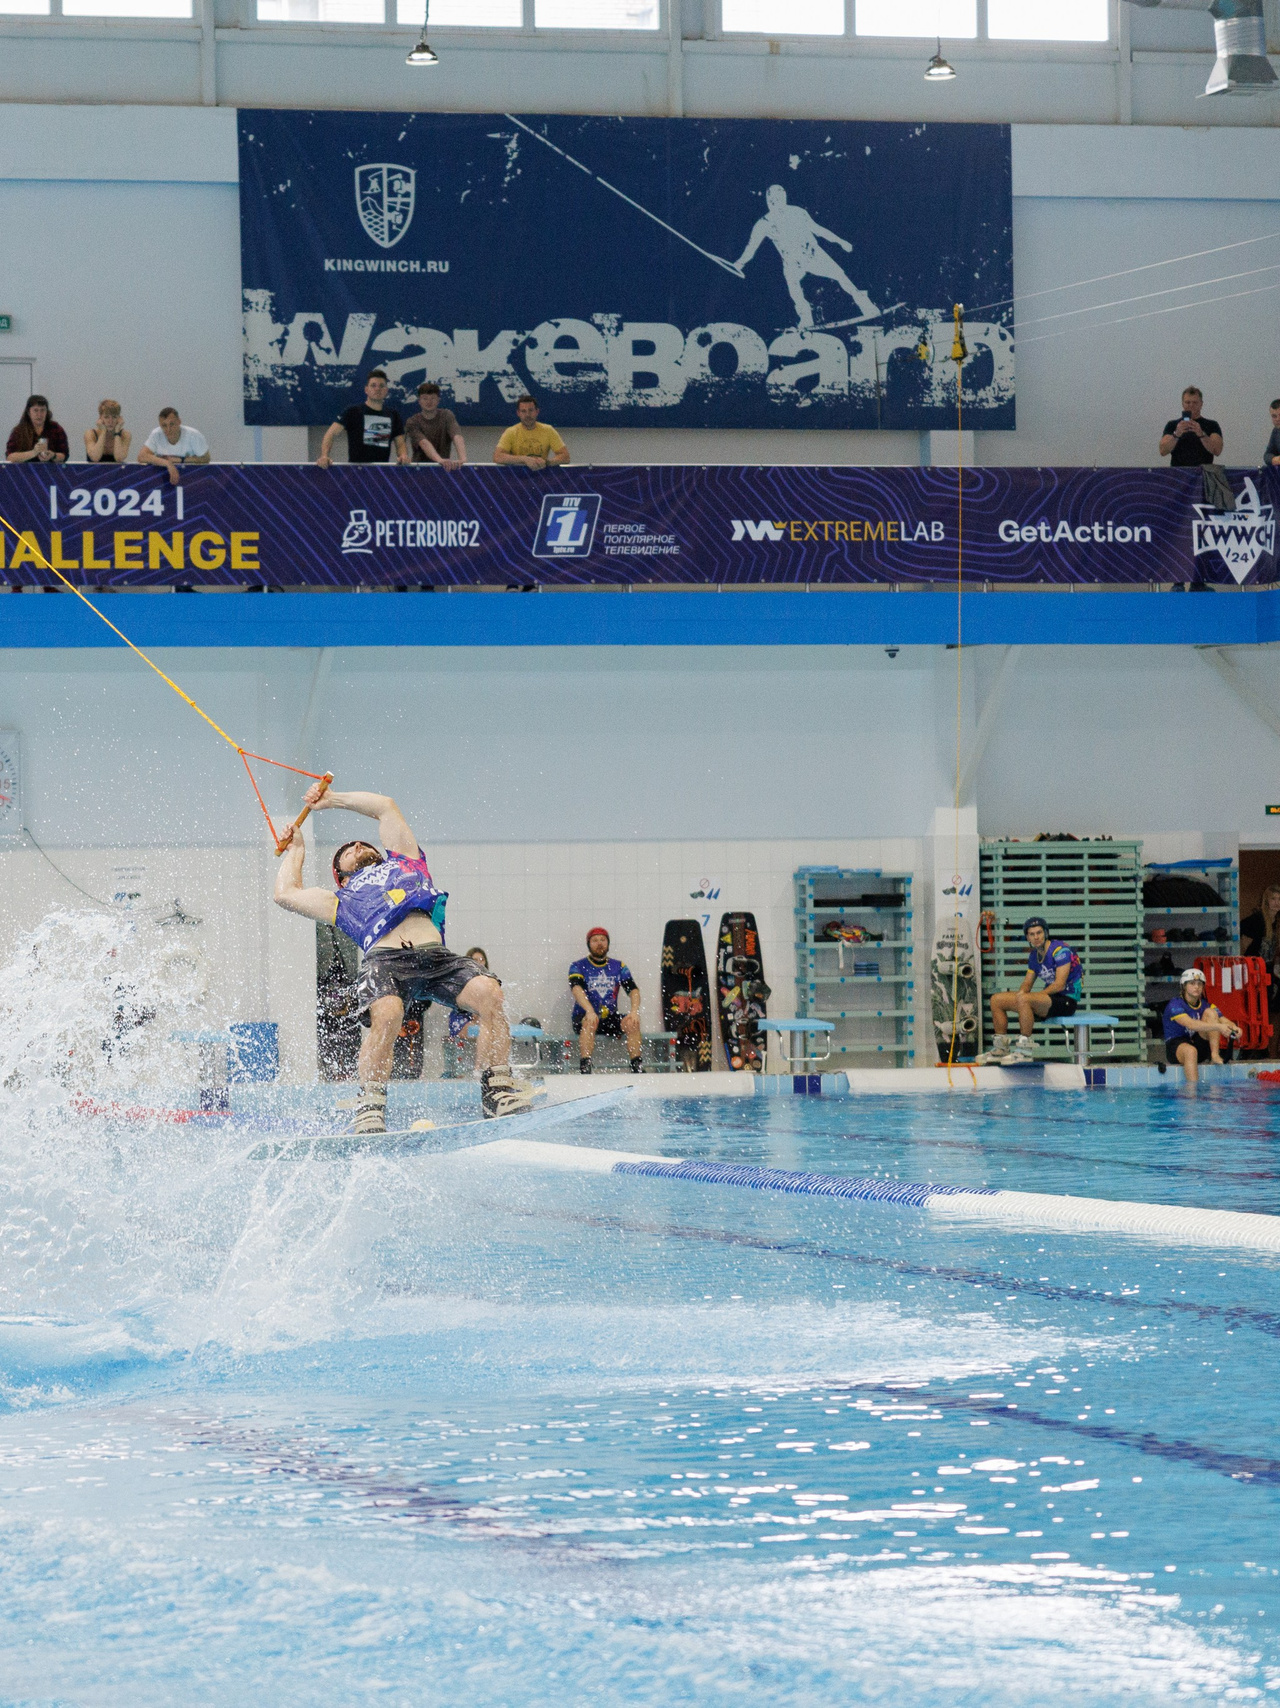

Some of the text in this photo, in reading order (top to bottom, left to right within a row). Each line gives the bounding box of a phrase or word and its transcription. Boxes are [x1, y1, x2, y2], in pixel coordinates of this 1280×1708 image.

[324, 258, 450, 274] KINGWINCH.RU
[376, 520, 480, 547] PETERBURG2
[604, 524, 646, 533] ПЕРВОЕ
[790, 520, 946, 542] EXTREMELAB
[998, 520, 1153, 544] GetAction
[604, 534, 676, 544] ПОПУЛЯРНОЕ
[1196, 522, 1274, 551] KWWCH
[605, 545, 680, 555] ТЕЛЕВИДЕНИЕ
[1231, 552, 1249, 563] 24
[701, 914, 710, 927] 7
